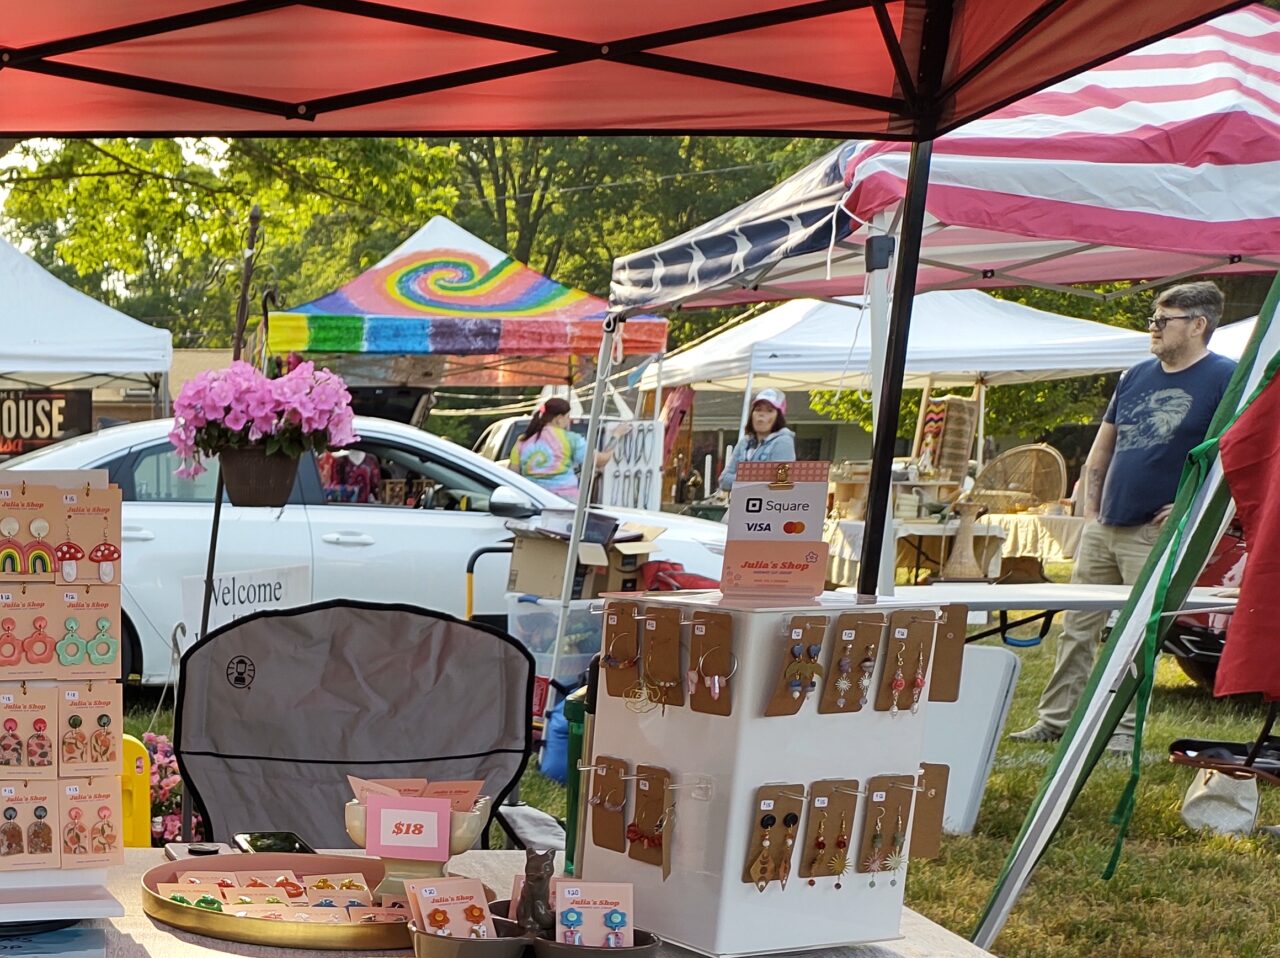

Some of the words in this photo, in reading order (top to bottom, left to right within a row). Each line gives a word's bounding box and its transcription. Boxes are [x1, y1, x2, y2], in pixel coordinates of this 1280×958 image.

[766, 500, 810, 514] Square
[745, 523, 772, 532] VISA
[740, 560, 778, 570] Julia's
[780, 561, 810, 572] Shop
[204, 576, 282, 606] Welcome
[392, 821, 424, 836] $18
[431, 895, 455, 904] Julia's
[570, 898, 597, 906] Julia's
[599, 899, 621, 907] Shop
